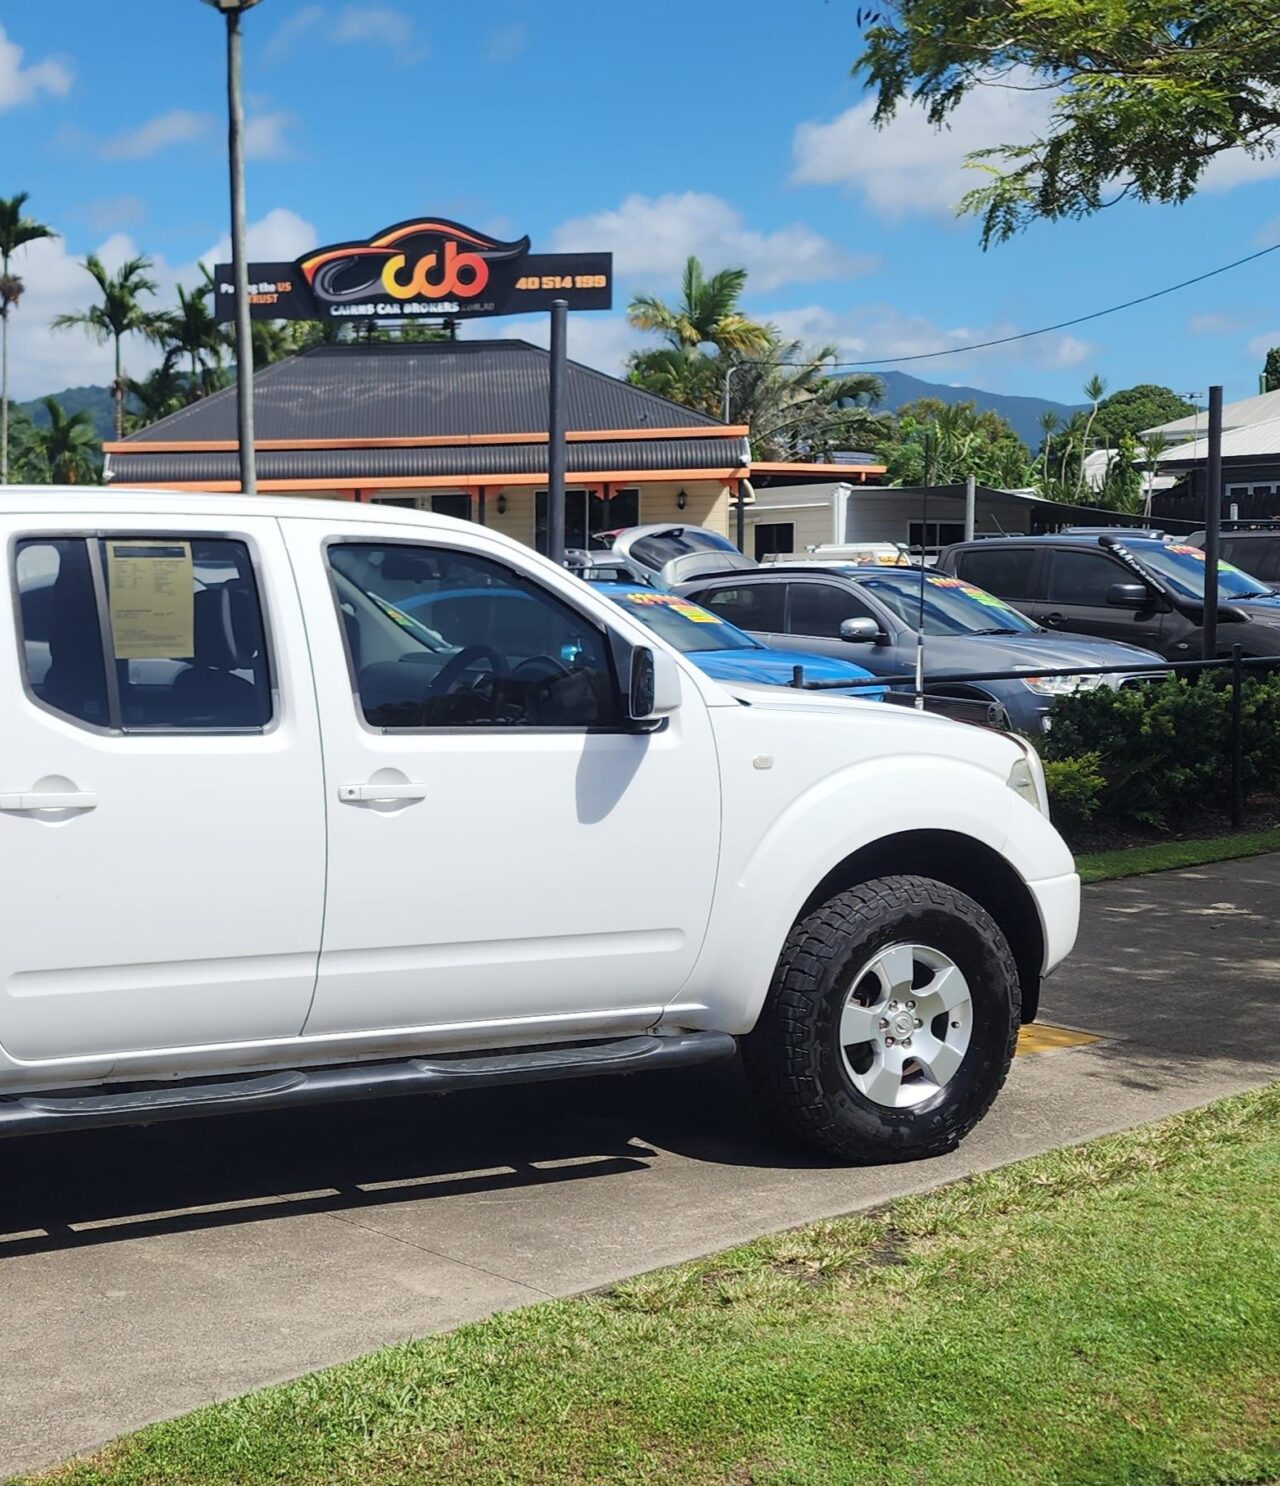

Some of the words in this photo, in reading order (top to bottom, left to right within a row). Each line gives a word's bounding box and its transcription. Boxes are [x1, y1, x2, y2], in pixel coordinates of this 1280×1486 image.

[259, 282, 276, 292] the
[515, 277, 540, 290] 40
[541, 276, 573, 289] 514
[575, 275, 607, 288] 199
[330, 303, 375, 316] CAIRNS
[376, 303, 401, 315] CAR
